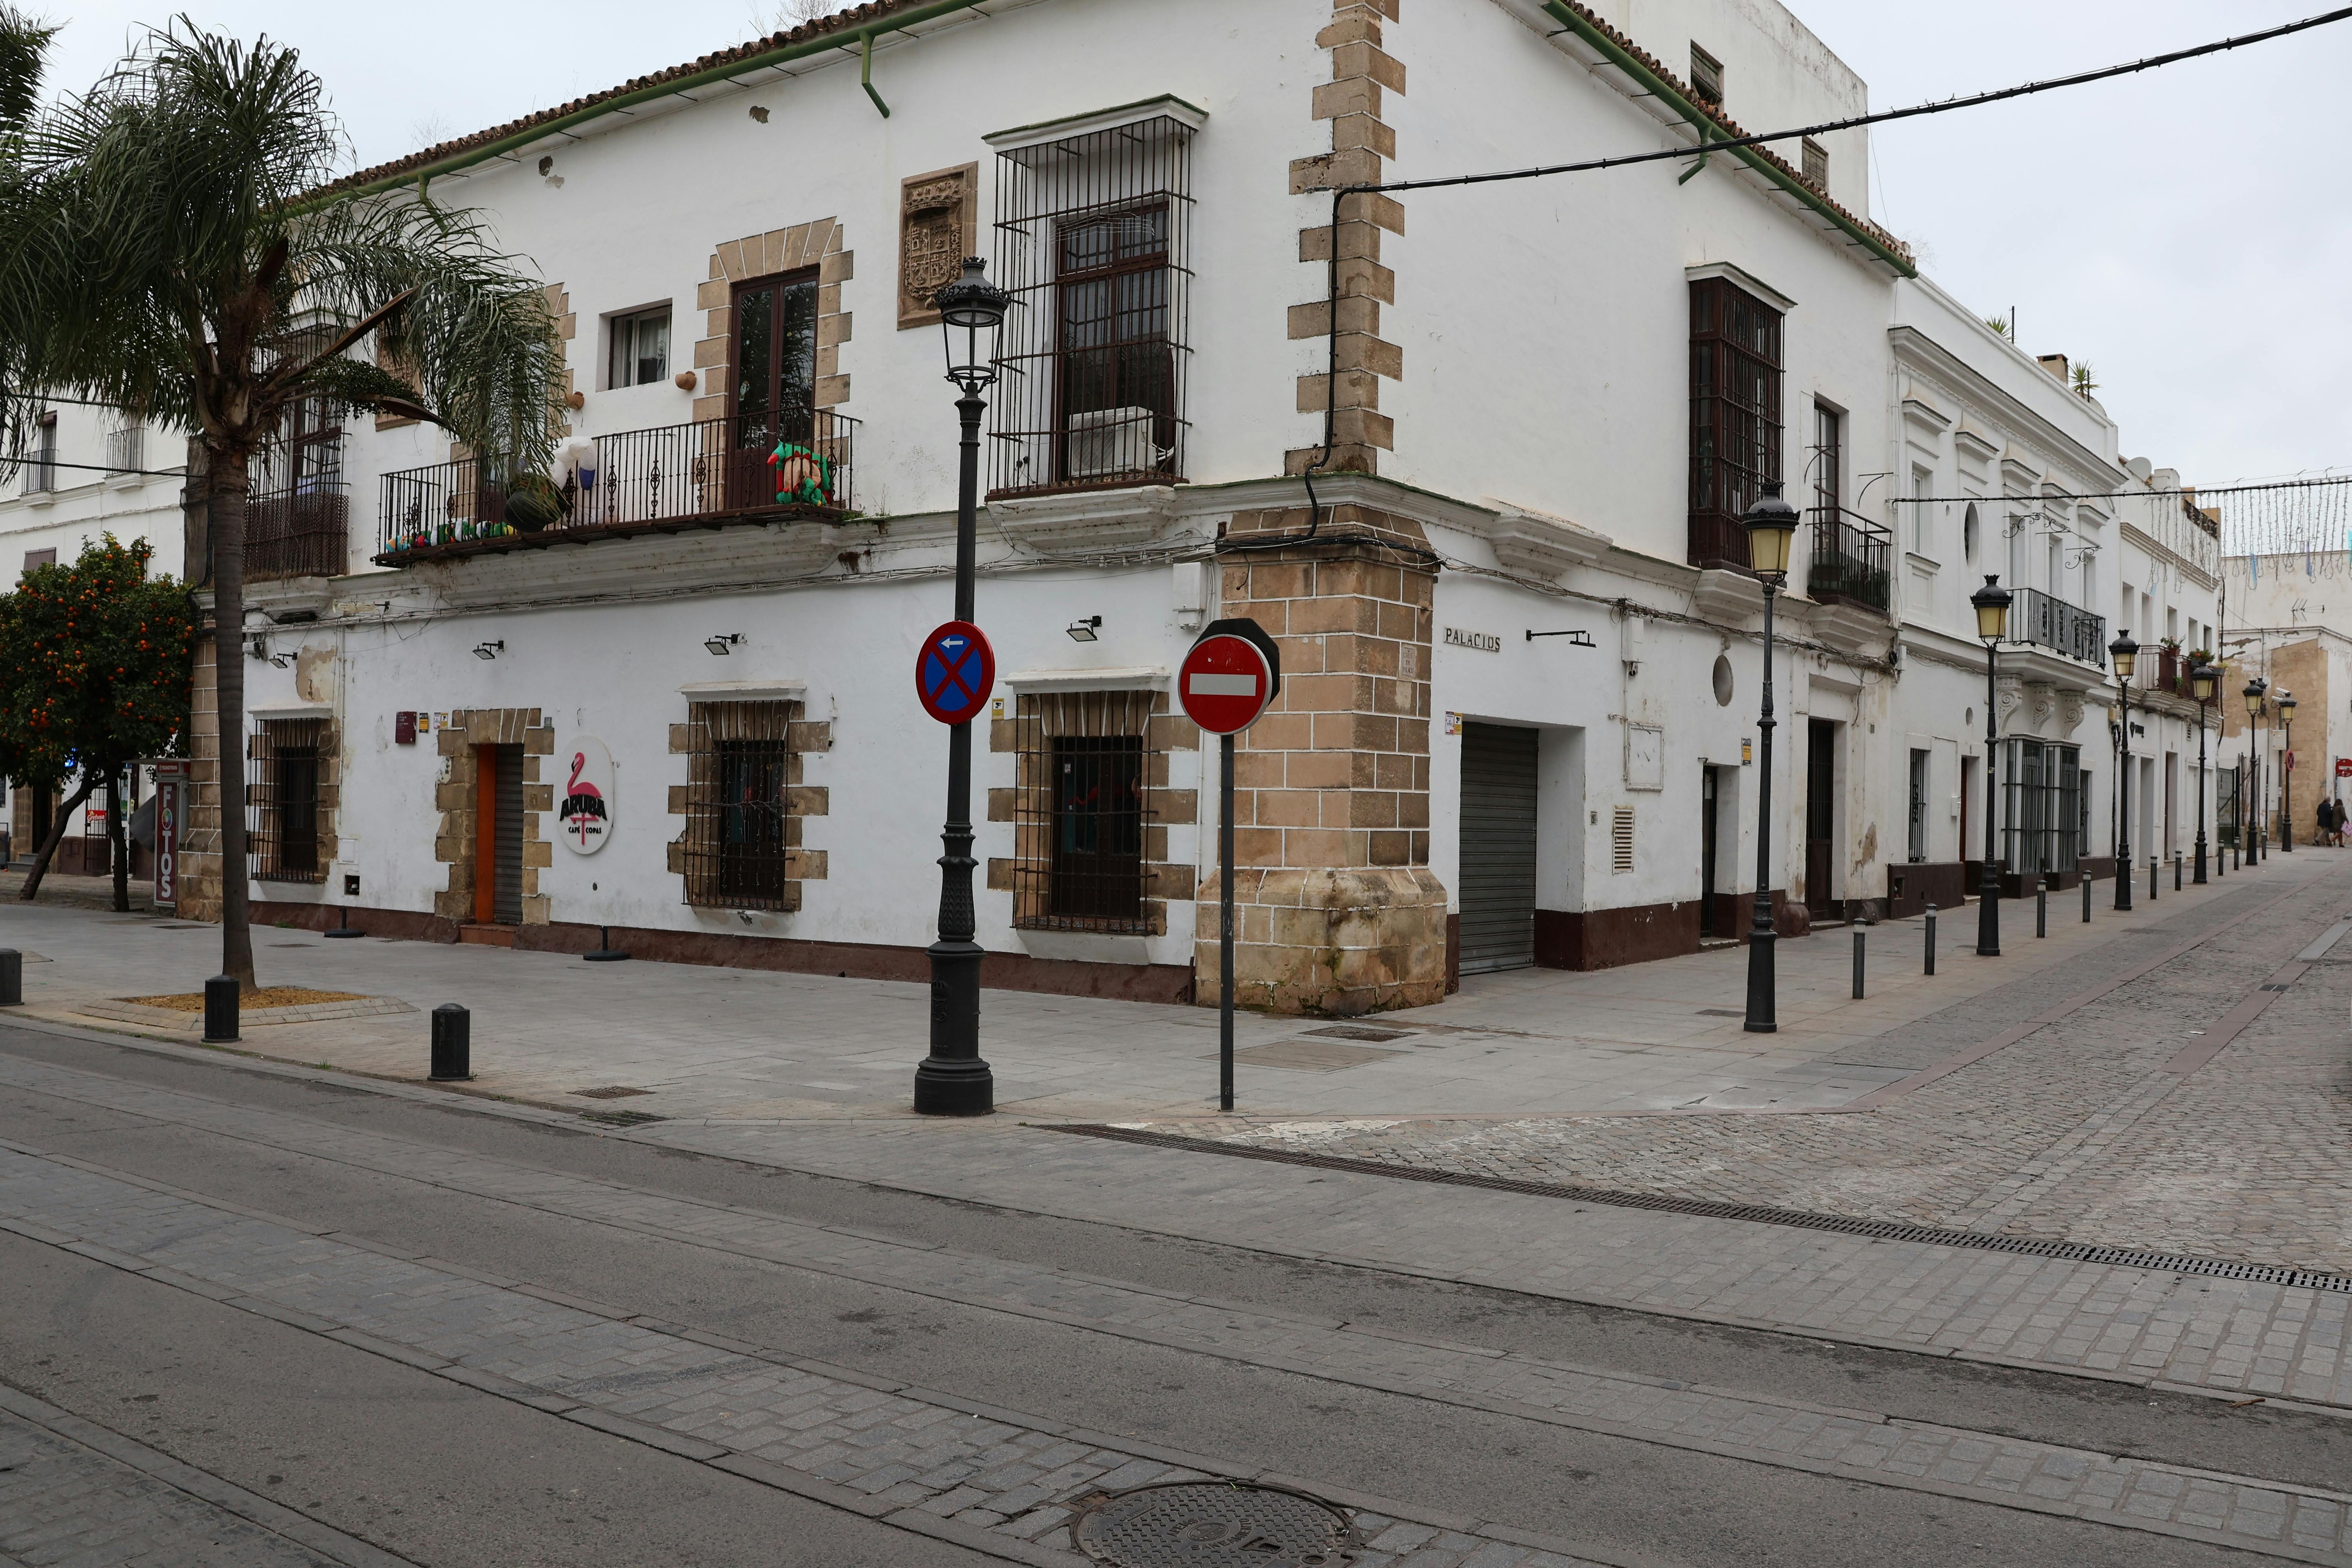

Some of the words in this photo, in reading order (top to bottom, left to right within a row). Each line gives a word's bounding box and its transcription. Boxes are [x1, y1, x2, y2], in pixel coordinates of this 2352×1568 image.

[1446, 628, 1500, 651] PALACIOS
[559, 794, 607, 821] ARUBA
[161, 786, 172, 898] FOTOS
[568, 825, 580, 833] CAFÉ
[1191, 1519, 1252, 1550] SANEAMIENTO
